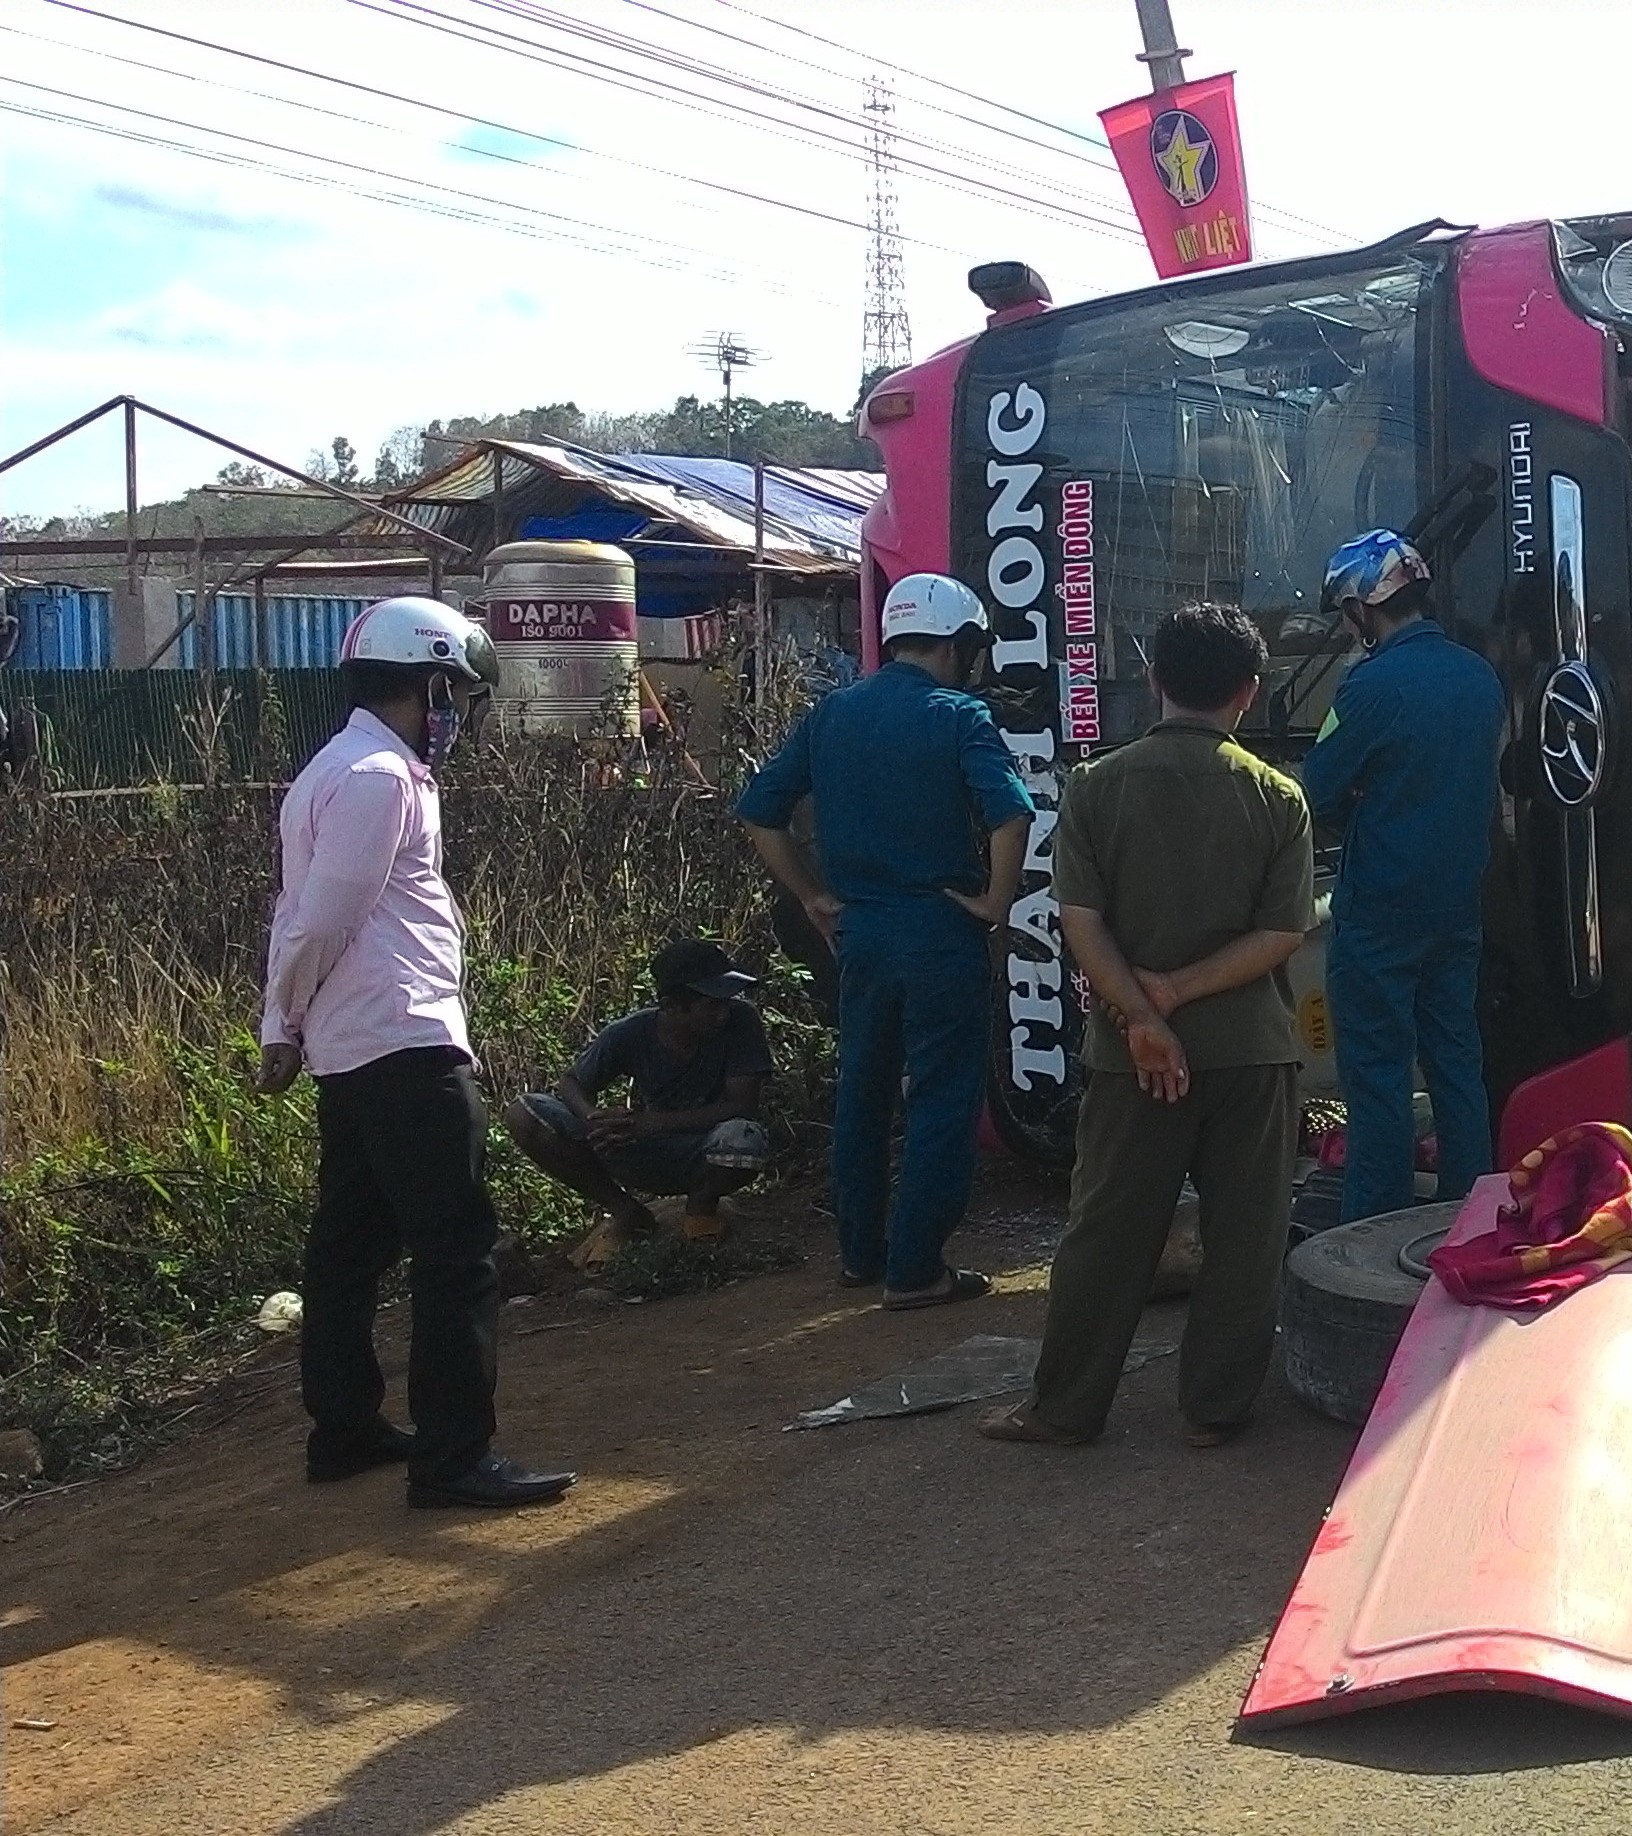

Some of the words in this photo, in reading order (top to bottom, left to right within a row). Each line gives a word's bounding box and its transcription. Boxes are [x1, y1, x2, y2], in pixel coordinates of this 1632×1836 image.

[987, 382, 1048, 673] LONG
[1057, 480, 1093, 558] ĐÔNG
[1509, 422, 1534, 573] HYUNDAI
[508, 603, 597, 624] DAPHA
[521, 623, 544, 638] ISO
[549, 625, 583, 638] 9001
[1055, 562, 1095, 635] MIỀN
[414, 628, 452, 639] HON
[1067, 643, 1097, 680] XE
[1060, 685, 1099, 740] BẾN
[999, 728, 1065, 1091] THANH
